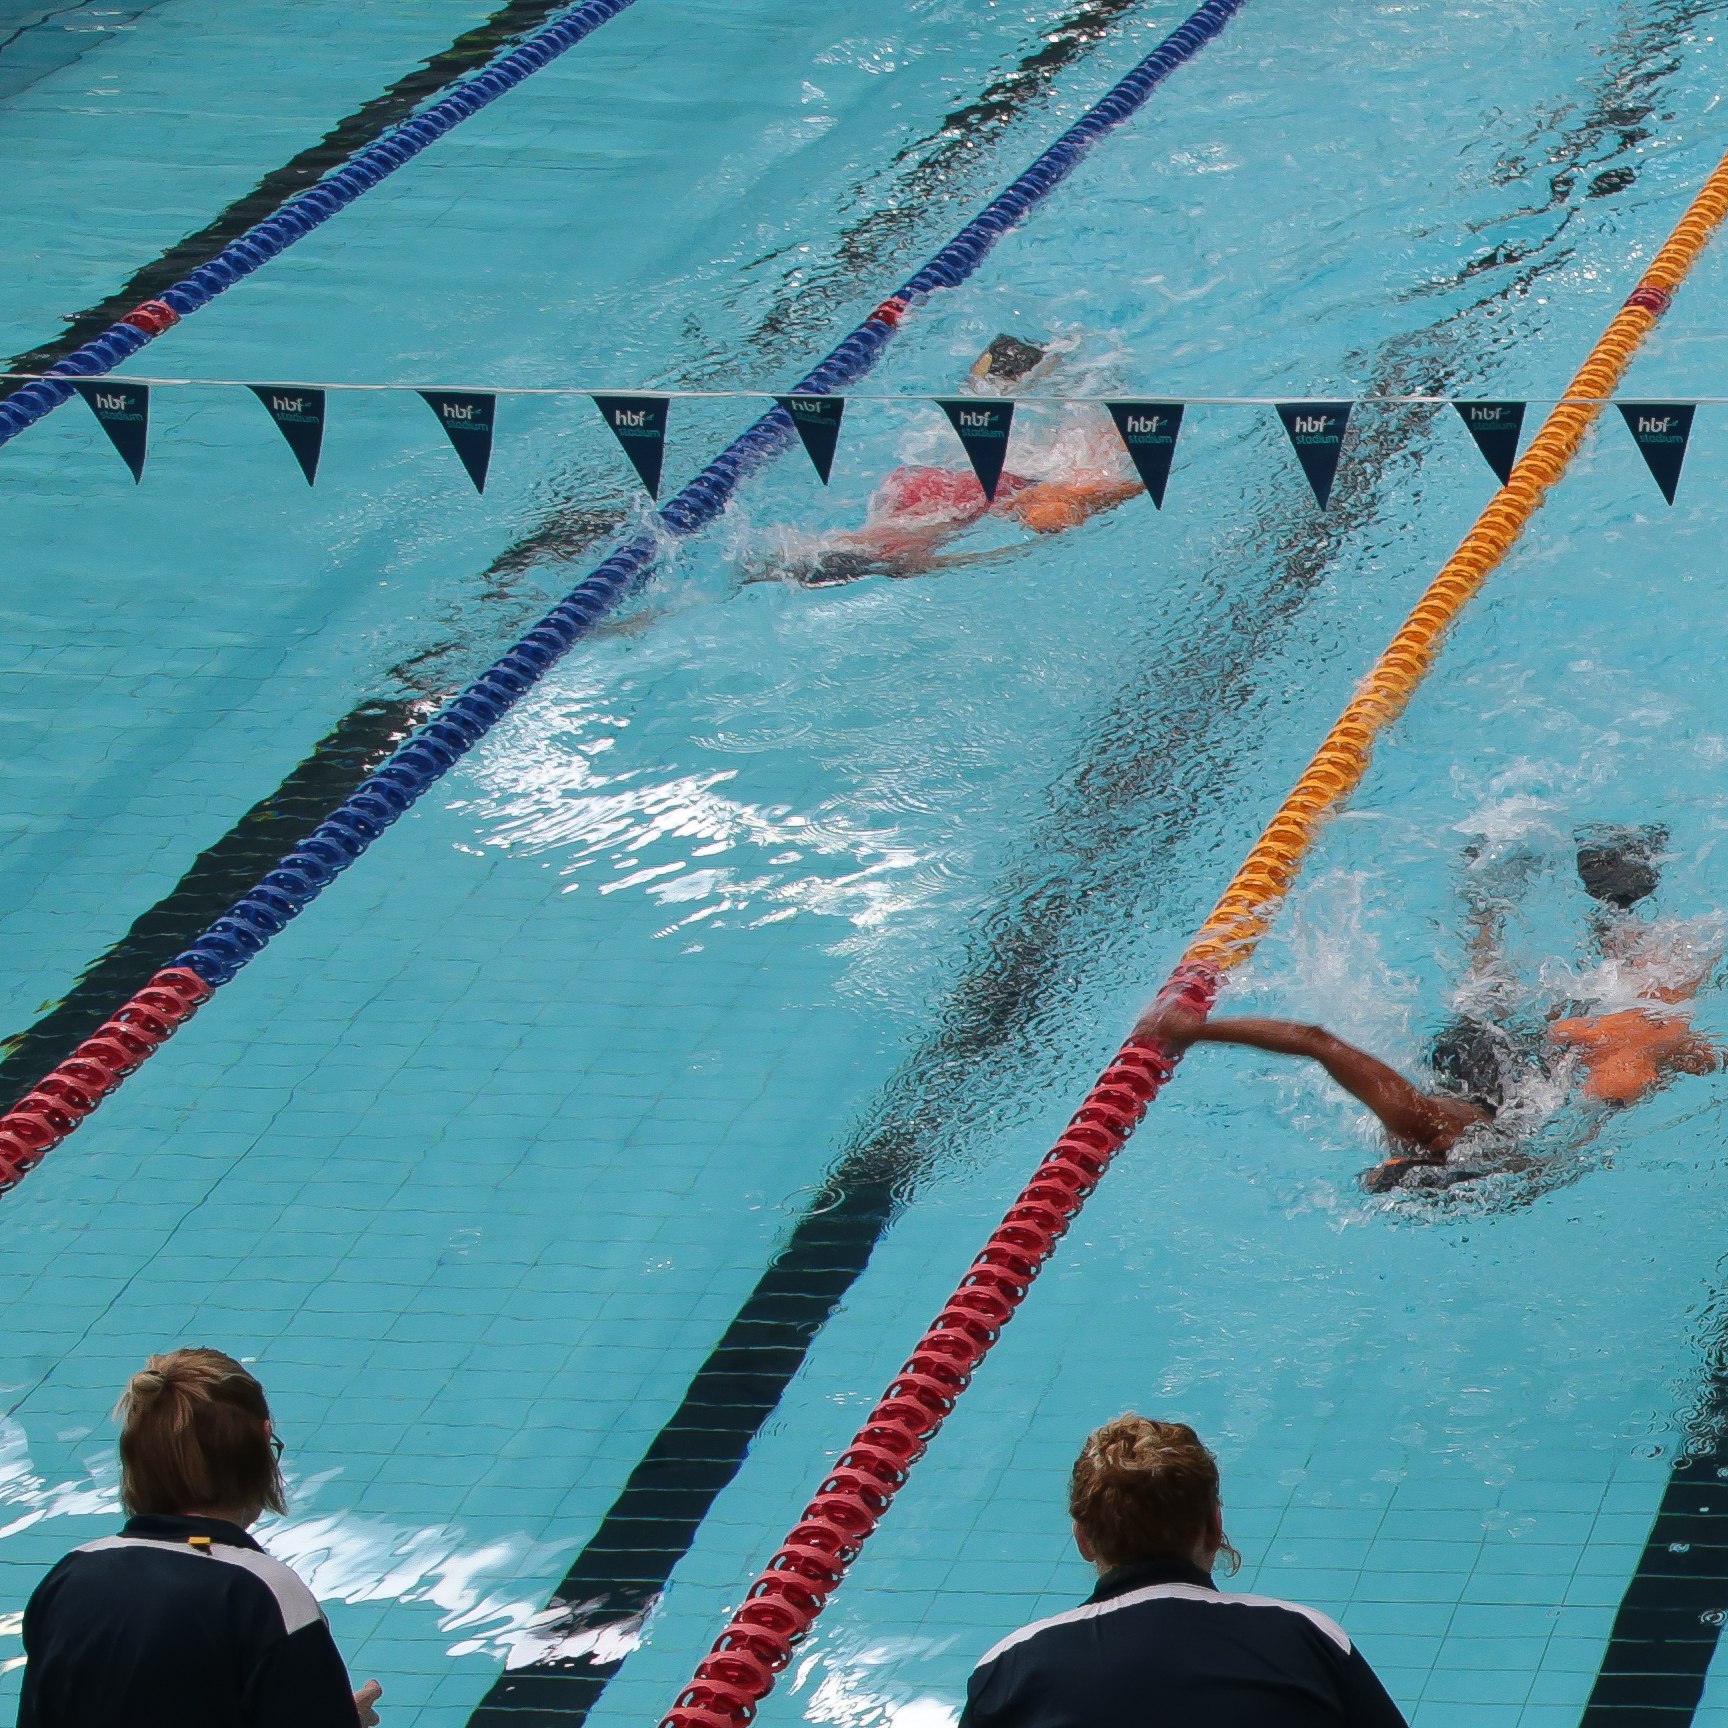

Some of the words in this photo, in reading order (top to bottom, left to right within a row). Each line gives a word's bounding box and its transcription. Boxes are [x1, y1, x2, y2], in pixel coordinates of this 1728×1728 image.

[95, 393, 127, 410] hbf
[273, 396, 303, 412] hbf
[791, 399, 822, 413] hbf
[99, 410, 143, 421] stadium
[443, 403, 474, 420] hbf
[615, 410, 646, 427] hbf
[1470, 407, 1503, 420] hbf
[446, 420, 489, 432] stadium
[959, 411, 991, 427] hbf
[1127, 416, 1159, 433] hbf
[1295, 415, 1328, 433] hbf
[1638, 416, 1670, 432] hbf
[619, 428, 661, 438] stadium
[961, 428, 1005, 439] stadium
[1128, 433, 1172, 444] stadium
[1295, 434, 1339, 445] stadium
[1638, 433, 1684, 444] stadium
